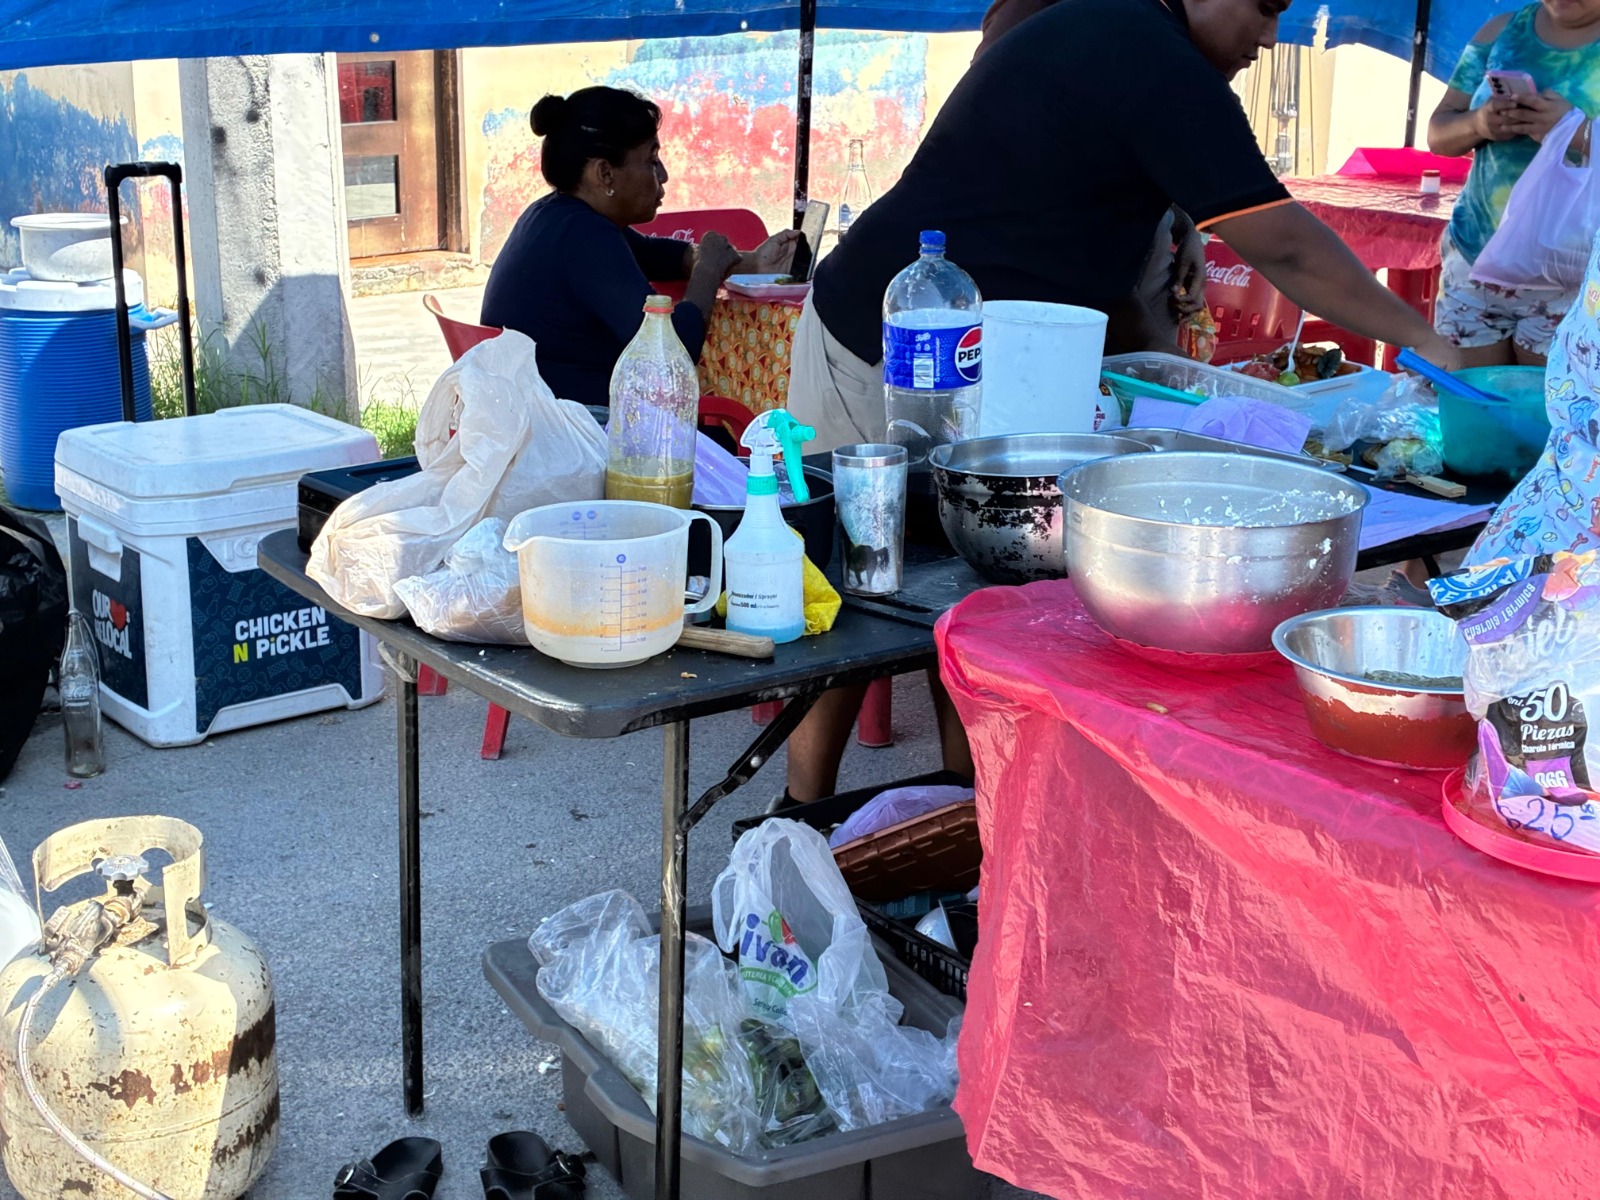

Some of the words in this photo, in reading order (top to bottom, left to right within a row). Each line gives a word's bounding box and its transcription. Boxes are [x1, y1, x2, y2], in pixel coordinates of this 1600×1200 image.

[958, 347, 982, 363] PEP
[92, 588, 115, 622] OUR
[234, 606, 327, 642] CHICKEN
[233, 643, 249, 664] N
[1519, 682, 1569, 722] 50
[1520, 723, 1575, 741] Piezas
